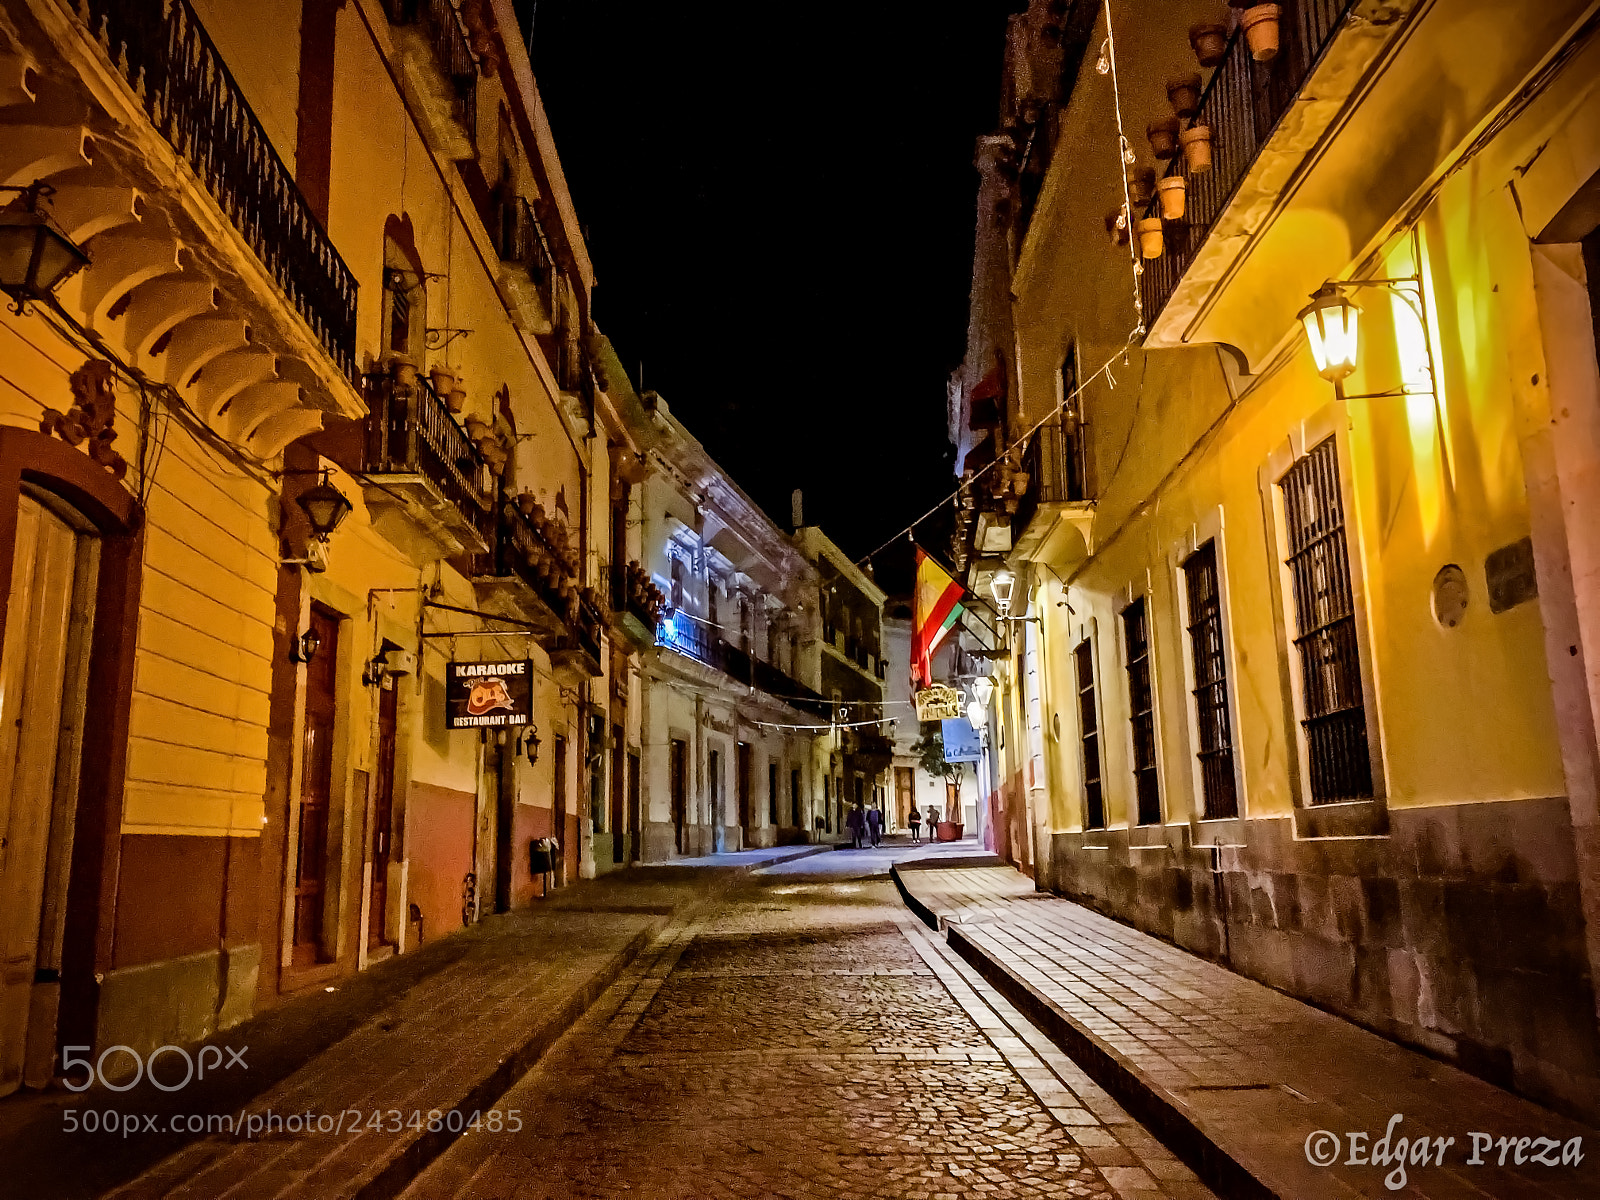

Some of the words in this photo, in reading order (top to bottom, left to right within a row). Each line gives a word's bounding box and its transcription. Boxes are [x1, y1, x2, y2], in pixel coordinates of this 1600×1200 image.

[455, 663, 525, 677] KARAOKE
[453, 715, 506, 727] RESTAURANT
[508, 714, 527, 725] BAR
